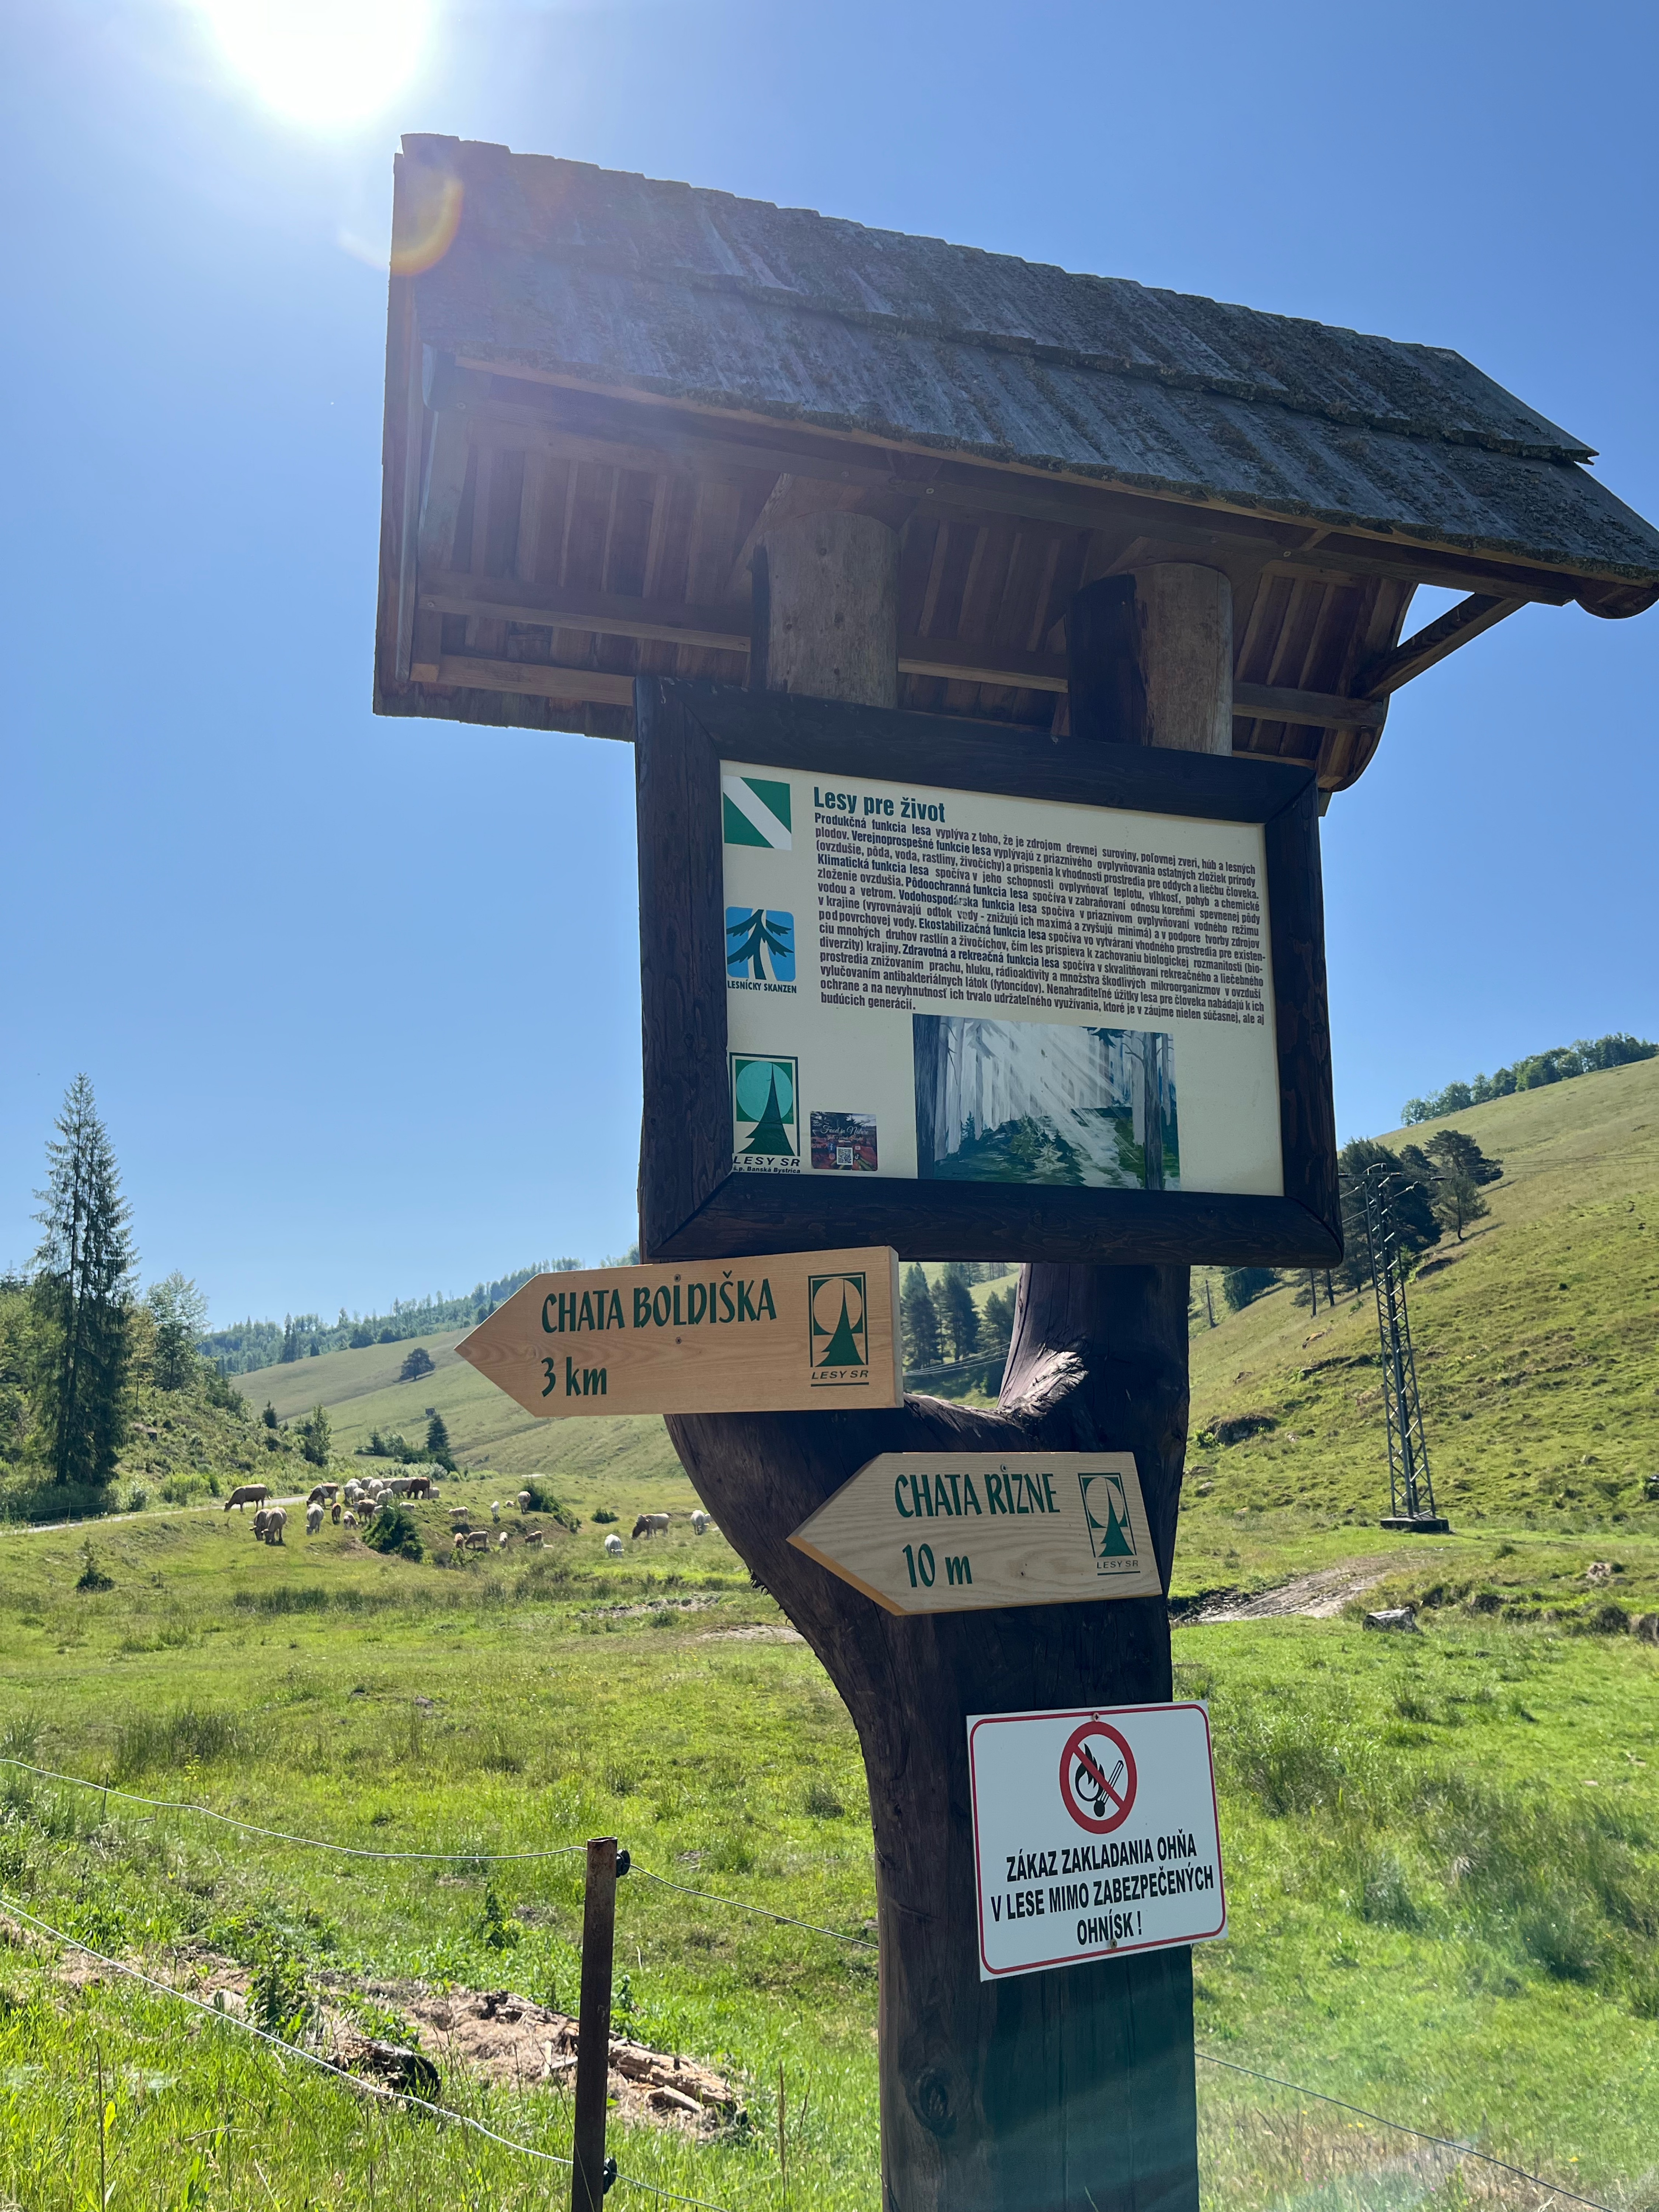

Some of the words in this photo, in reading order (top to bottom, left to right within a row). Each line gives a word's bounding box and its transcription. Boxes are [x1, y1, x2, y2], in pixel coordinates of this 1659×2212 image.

[814, 786, 857, 813] Lesy
[864, 796, 894, 815] pre
[901, 797, 945, 822] život
[814, 812, 866, 829] Produkčná
[872, 819, 906, 833] funkcia
[912, 824, 931, 836] lesa
[936, 828, 969, 841] vyplýva
[978, 832, 1001, 846] toho,
[1026, 838, 1061, 851] zdrojom
[1066, 843, 1097, 857] drevnej
[1102, 849, 1139, 862] suroviny,
[1141, 853, 1176, 866] poľovnej
[1225, 862, 1255, 874] lesných
[815, 827, 849, 840] plodov.
[851, 830, 934, 849] Verejnoprospešné
[936, 840, 970, 854] funkcie
[972, 844, 991, 856] lesa
[993, 848, 1034, 862] vyplývajú
[1043, 854, 1092, 868] priaznivého
[1097, 860, 1155, 875] ovplyvňovania
[1158, 867, 1196, 880] ostatných
[1198, 871, 1227, 884] zložiek
[1228, 874, 1255, 888] prírody
[817, 839, 864, 857] (ovzdušie,
[867, 846, 893, 860] pôda,
[895, 850, 920, 863] voda,
[922, 853, 958, 867] rastliny,
[960, 858, 1005, 872] živočíchy)
[1013, 864, 1053, 876] prispenia
[1062, 867, 1102, 882] vhodnosti
[1104, 874, 1145, 887] prostredia
[1162, 880, 1192, 892] oddych
[1199, 883, 1224, 895] liečbu
[1226, 886, 1259, 899] človeka.
[818, 853, 869, 869] Klimatická
[872, 859, 906, 873] funkcia
[935, 869, 970, 880] spočíva
[1007, 875, 1054, 890] schopnosti
[1059, 882, 1109, 895] ovplyvňovať
[1113, 887, 1144, 901] teplotu,
[1149, 891, 1181, 904] vlhkosť,
[1186, 895, 1210, 907] pohyb
[1221, 898, 1260, 912] chemické
[817, 867, 857, 882] zloženie
[860, 873, 904, 887] ovzdušia.
[905, 876, 971, 894] Pôdoochranná
[973, 884, 1006, 897] funkcia
[1032, 891, 1066, 904] spočíva
[1075, 896, 1126, 910] zabraňovaní
[1162, 904, 1195, 917] koreňmi
[1200, 910, 1239, 923] spevnenej
[1242, 914, 1260, 925] pôdy
[818, 882, 846, 894] vodou
[860, 887, 896, 899] vetrom.
[982, 898, 1015, 912] funkcia
[1041, 905, 1075, 918] spočíva
[1087, 911, 1133, 924] priaznivom
[1137, 916, 1189, 929] ovplyvňovaní
[1194, 921, 1227, 933] vodného
[1232, 926, 1259, 936] režimu
[826, 895, 860, 909] krajine
[863, 899, 921, 916] (vyrovnávajú
[927, 906, 952, 918] odtok
[987, 914, 1018, 925] znižujú
[1037, 918, 1072, 930] maximá
[1082, 922, 1113, 935] zvyšujú
[1117, 927, 1151, 939] minimá)
[1168, 931, 1201, 943] podpore
[1231, 937, 1260, 949] zdrojov
[893, 917, 917, 929] vody.
[919, 918, 991, 935] Ekostabilizačná
[993, 925, 1026, 938] funkcia
[1048, 933, 1082, 944] spočíva
[1135, 940, 1175, 953] vhodného
[1176, 945, 1217, 957] prostredia
[1234, 951, 1266, 961] existen-
[820, 936, 863, 952] diverzity)
[866, 940, 901, 955] krajiny.
[902, 943, 948, 958] Zdravotná
[959, 949, 1004, 963] rekreačná
[1006, 953, 1039, 967] funkcia
[1062, 960, 1095, 972] spočíva
[1104, 963, 1158, 977] skvalitňovaní
[1161, 968, 1211, 982] rekreačného
[837, 926, 880, 939] mnohých
[886, 929, 917, 942] druhov
[919, 933, 949, 945] rastlín
[959, 937, 1009, 952] živočíchov,
[1045, 945, 1085, 957] prispieva
[1094, 949, 1142, 963] zachovaniu
[1144, 953, 1189, 968] biologickej
[1193, 959, 1242, 972] rozmanitosti
[1245, 963, 1263, 974] (bio-
[727, 979, 761, 991] LESNÍCKY
[764, 983, 797, 994] SKANZEN
[820, 952, 868, 965] prostredia
[871, 956, 924, 970] znižovaním
[929, 961, 963, 975] prachu,
[966, 963, 993, 977] hluku,
[1060, 973, 1100, 985] množstva
[1102, 975, 1146, 990] škodlivých
[1151, 980, 1220, 995] mikroorganizmov
[1231, 988, 1261, 999] ovzduší
[820, 965, 880, 980] vylučovaním
[883, 971, 963, 987] antibakteriálnych
[965, 976, 988, 989] látok
[1046, 983, 1112, 999] Nenahraditeľné
[1114, 989, 1139, 1002] úžitky
[1175, 994, 1206, 1007] človeka
[1208, 998, 1244, 1011] nabádajú
[820, 978, 859, 991] ochrane
[885, 984, 946, 999] nevyhnutnosť
[966, 990, 992, 1002] trvalo
[994, 993, 1052, 1007] udržateľného
[1054, 999, 1101, 1012] využívania,
[1103, 1001, 1125, 1013] ktoré
[1144, 1005, 1174, 1018] záujme
[1203, 1010, 1241, 1024] súčasnej,
[821, 992, 865, 1006] budúcich
[868, 998, 916, 1010] generácií.
[734, 1156, 775, 1165] LESY
[780, 1158, 800, 1166] SR
[542, 1289, 625, 1333] CHATA
[634, 1270, 777, 1328] BOLDIŠKA
[541, 1357, 556, 1397] 3
[566, 1357, 606, 1396] km
[811, 1371, 847, 1379] LESY
[895, 1474, 982, 1517] CHATA
[902, 1544, 935, 1587] 10
[945, 1556, 972, 1585] m
[1006, 1849, 1058, 1882] ZÁKAZ
[1062, 1839, 1154, 1874] ZAKLADANIA
[1158, 1829, 1197, 1861] OHŇA
[991, 1895, 1001, 1922] V
[1007, 1889, 1044, 1920] LESE
[1049, 1882, 1089, 1913] MIMO
[1094, 1862, 1214, 1906] ZABEZPEČENÝCH
[1077, 1909, 1133, 1945] OHNÍSK
[1137, 1910, 1142, 1935] !
